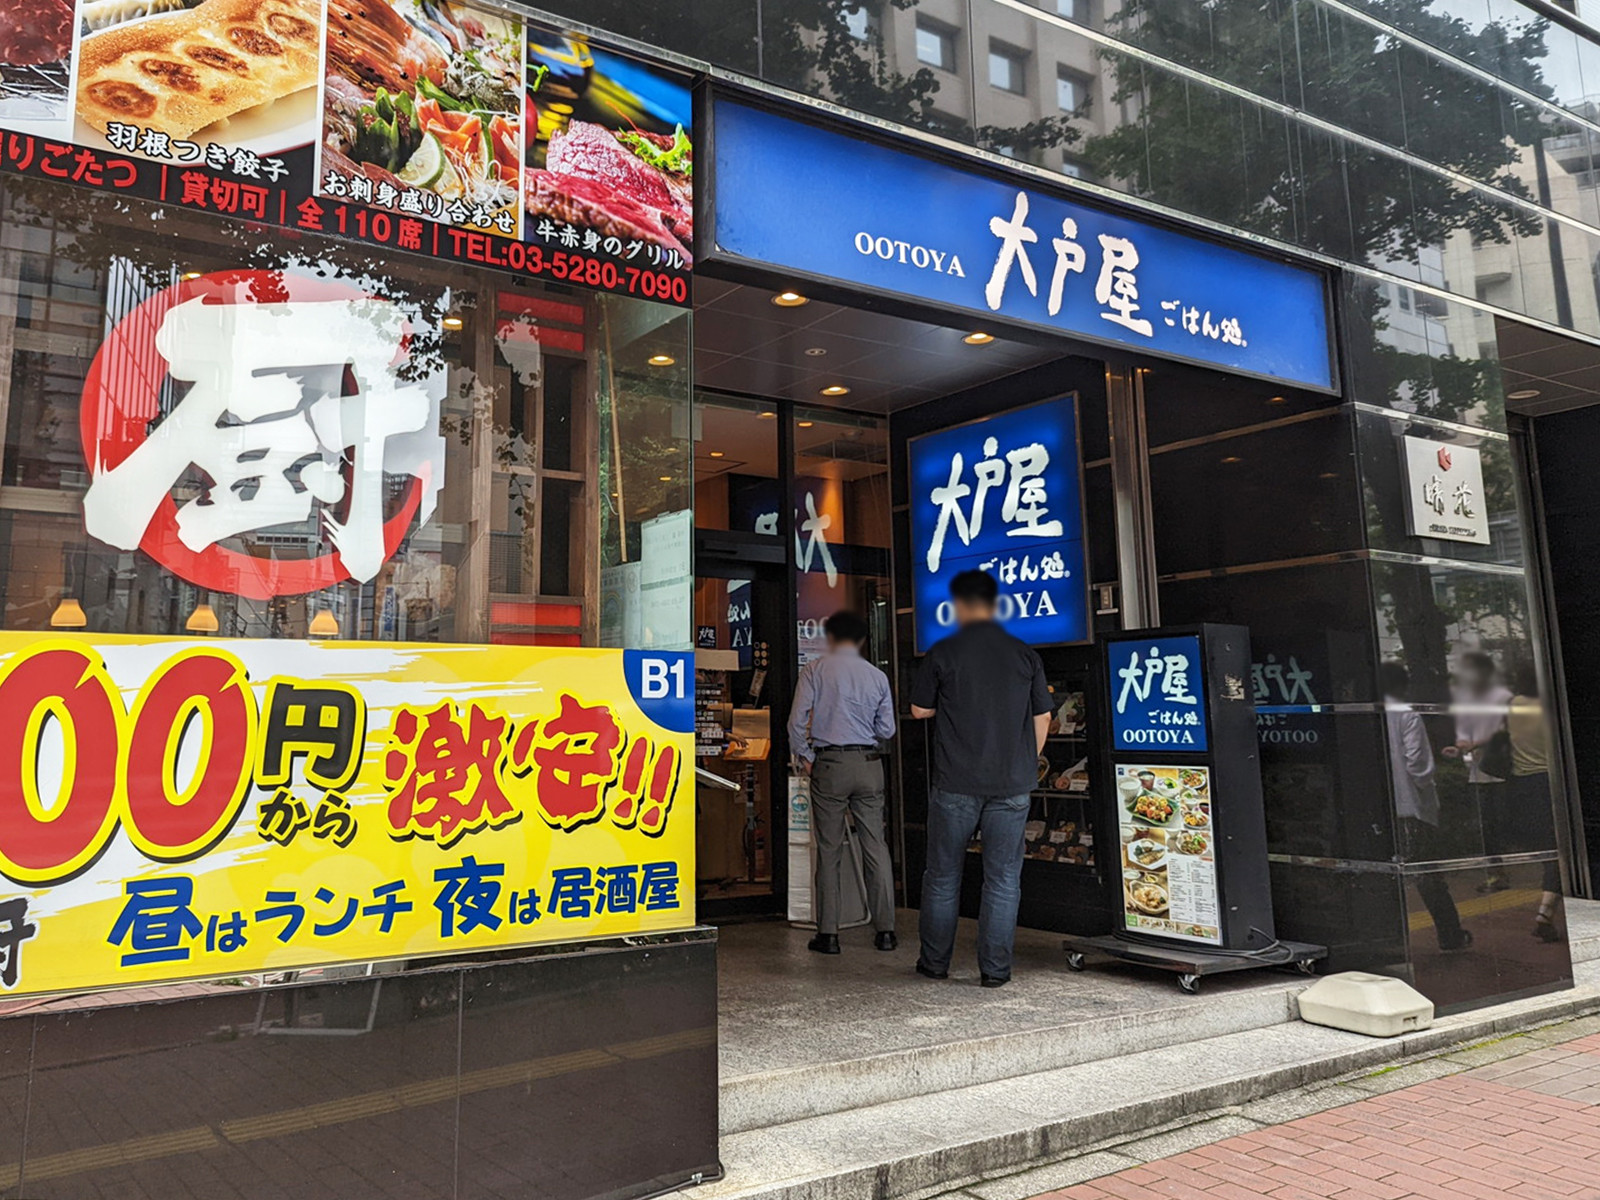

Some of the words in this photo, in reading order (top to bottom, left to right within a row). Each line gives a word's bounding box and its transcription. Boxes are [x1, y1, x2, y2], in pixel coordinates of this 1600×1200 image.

[107, 121, 291, 184] 羽根つき餃子
[0, 131, 137, 188] りごたつ
[180, 170, 269, 219] 貸切可
[448, 228, 688, 303] TEL:03-5280-7090
[323, 170, 516, 234] お刺身盛り合わせ
[535, 218, 685, 271] 牛赤身のグリル
[854, 231, 966, 278] OOTOYA
[984, 190, 1154, 337] 大戸屋
[926, 436, 1064, 573] 大戸屋
[935, 589, 1059, 627] OOYA
[641, 658, 685, 699] B1
[1116, 646, 1197, 714] 大戸屋
[1123, 729, 1194, 744] OOTOYA
[258, 789, 355, 843] から
[108, 876, 412, 967] 昼はランチ
[433, 856, 679, 938] 夜は居酒屋
